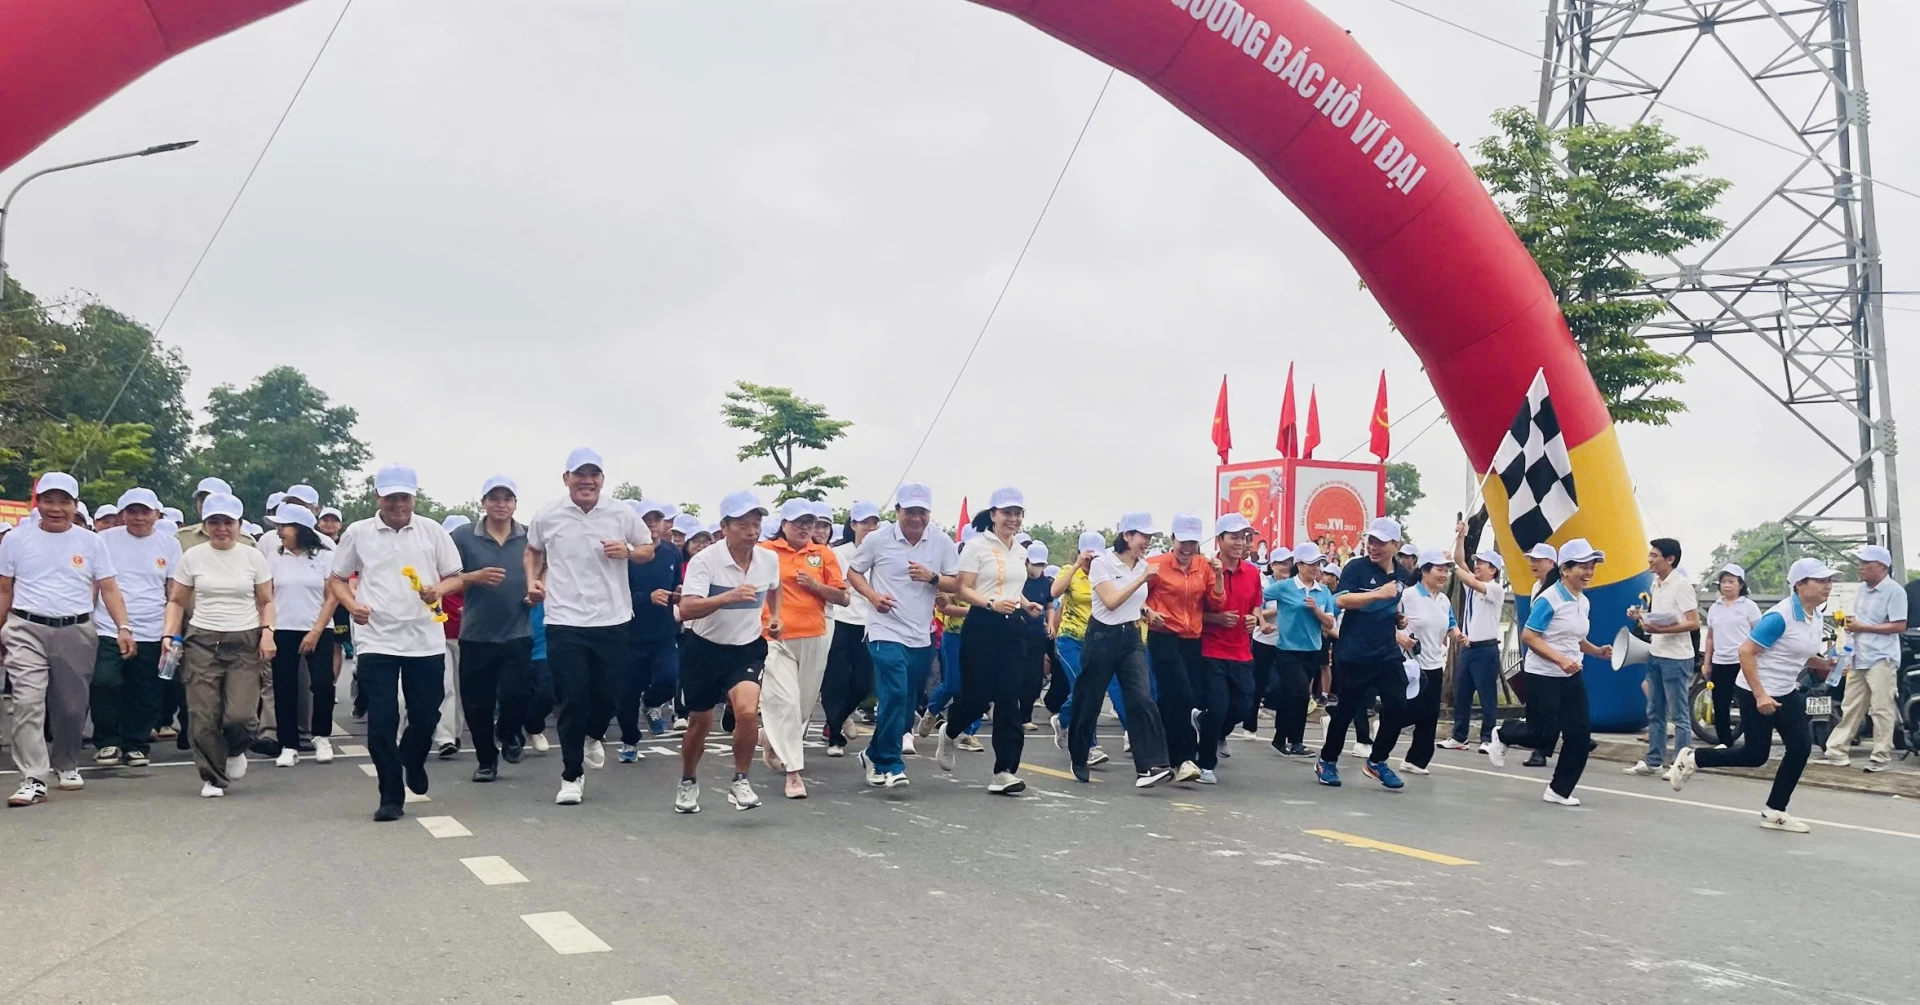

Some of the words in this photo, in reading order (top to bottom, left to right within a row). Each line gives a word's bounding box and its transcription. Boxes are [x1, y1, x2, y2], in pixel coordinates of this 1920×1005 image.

[1262, 34, 1325, 98] BÁC
[1313, 77, 1362, 128] HỒ
[1350, 109, 1391, 154] VĨ
[1373, 136, 1427, 195] ĐẠI
[1328, 518, 1344, 531] XVI
